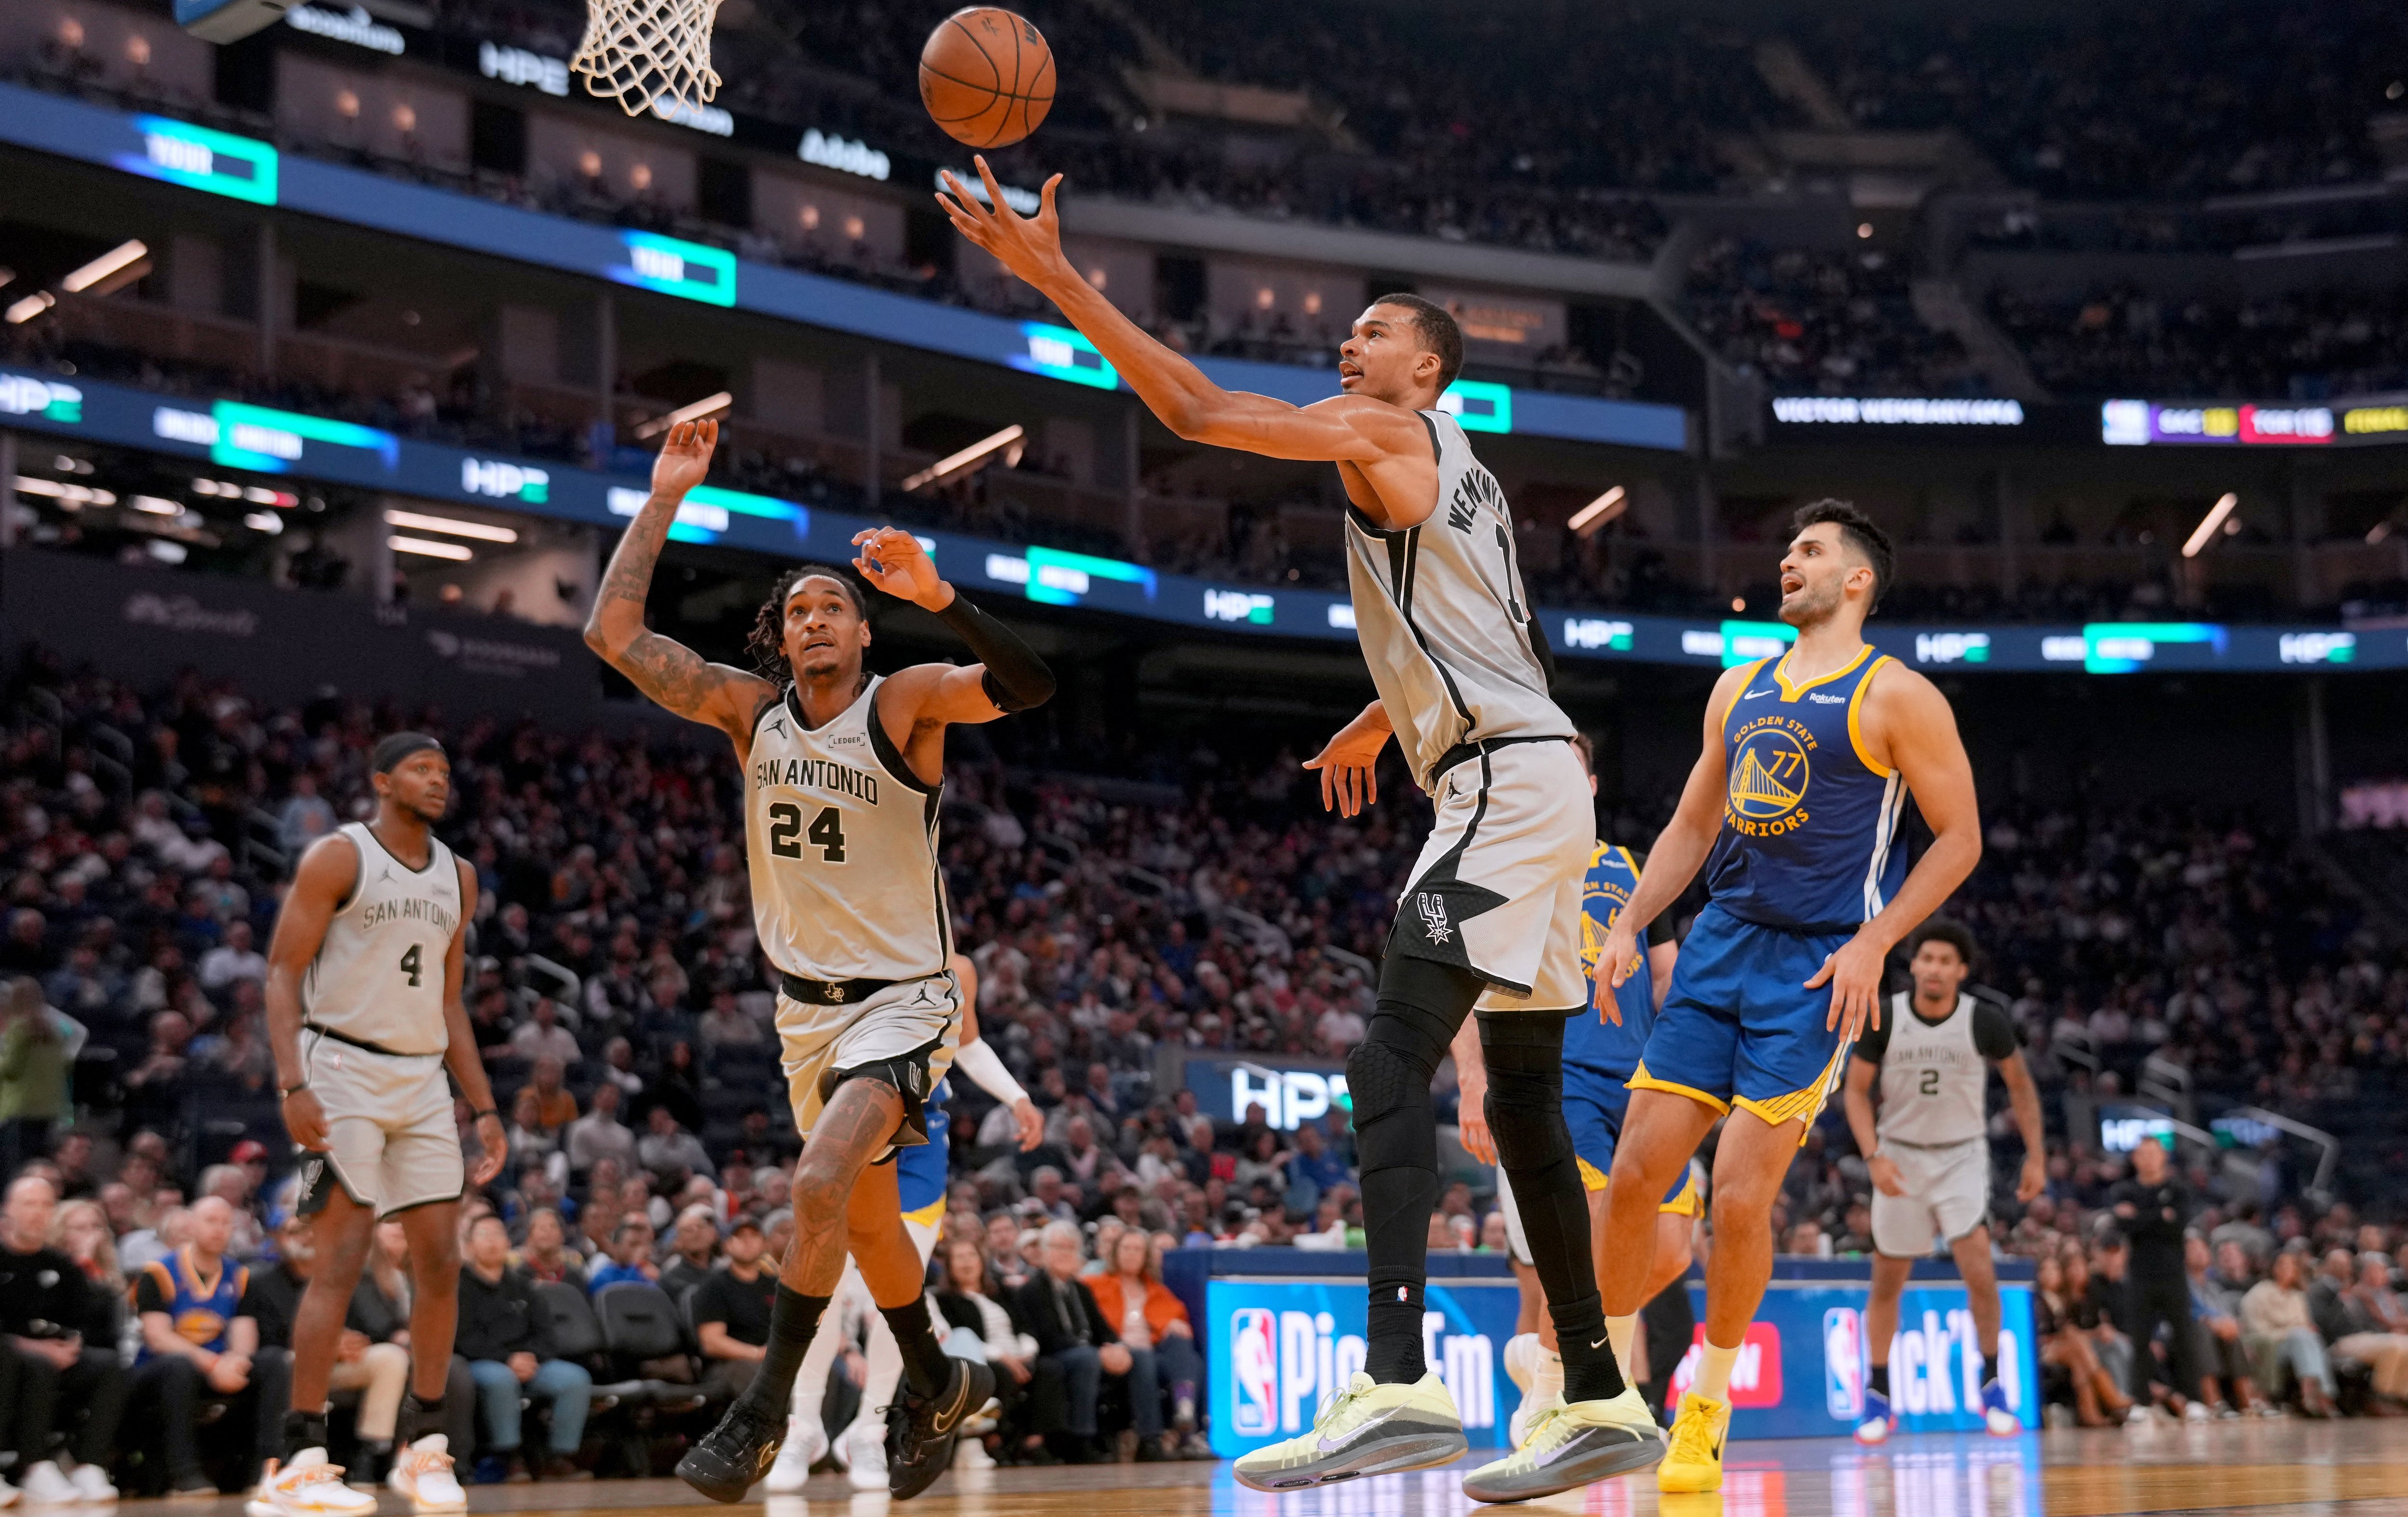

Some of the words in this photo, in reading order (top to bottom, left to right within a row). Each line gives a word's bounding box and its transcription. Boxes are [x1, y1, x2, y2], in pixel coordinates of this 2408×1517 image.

[479, 41, 569, 96] HPE
[1773, 397, 1860, 422] VICTOR
[461, 457, 549, 504] HPE
[1495, 522, 1528, 626] 1
[1203, 588, 1275, 625] HPE
[1809, 692, 1846, 704] Rakuten
[1734, 716, 1784, 743] GOLDEN
[1786, 718, 1818, 751] STATE
[757, 758, 782, 792] SAN
[783, 758, 879, 808] ANTONIO
[1768, 750, 1802, 778] 77
[768, 801, 847, 864] 24
[1724, 797, 1809, 837] WARRIORS
[363, 898, 398, 929] SAN
[403, 897, 457, 943] ANTONIO
[400, 942, 426, 988] 4
[1920, 1068, 1939, 1095] 2
